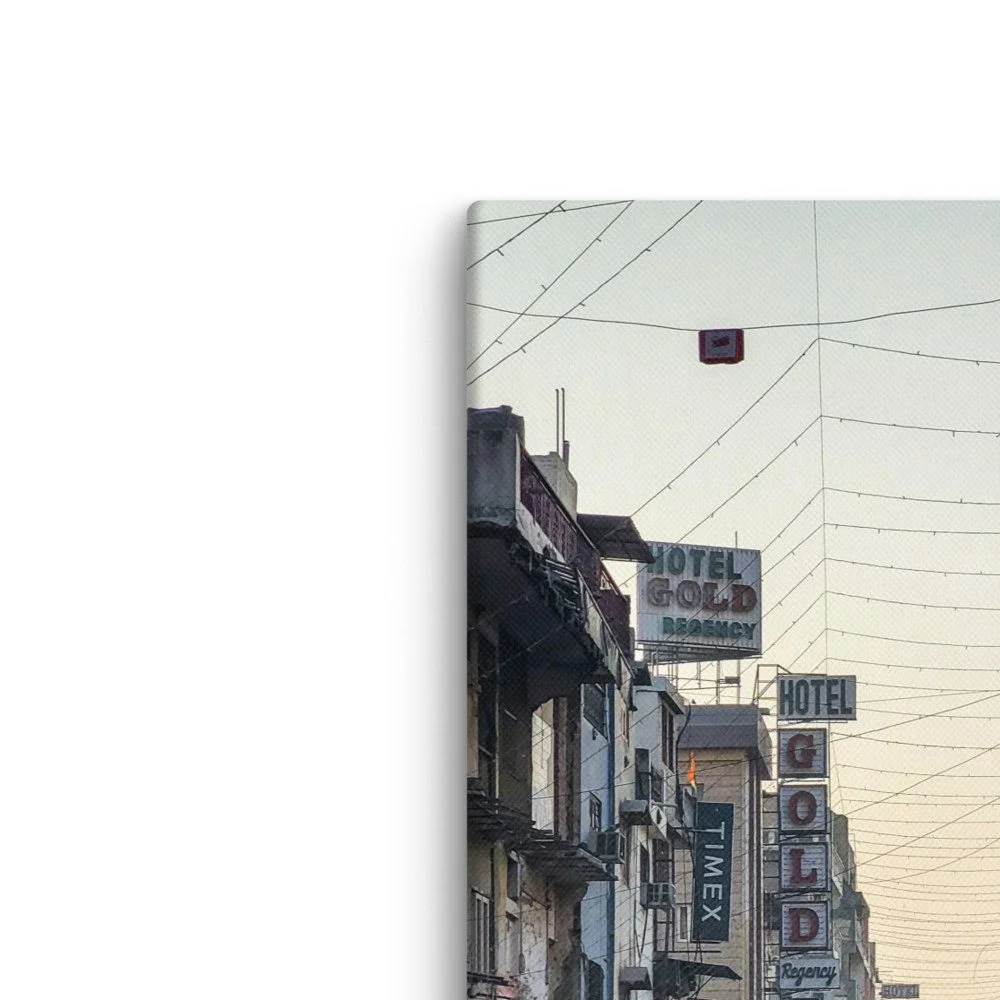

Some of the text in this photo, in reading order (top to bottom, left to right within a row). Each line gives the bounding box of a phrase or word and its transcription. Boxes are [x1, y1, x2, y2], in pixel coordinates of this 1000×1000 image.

[647, 546, 741, 579] HOTEL
[646, 577, 757, 612] GOLD
[662, 617, 757, 640] REGENCY
[780, 679, 852, 716] HOTEL
[787, 733, 820, 943] GOLD
[702, 821, 725, 922] TIMEX
[782, 962, 837, 987] Regency
